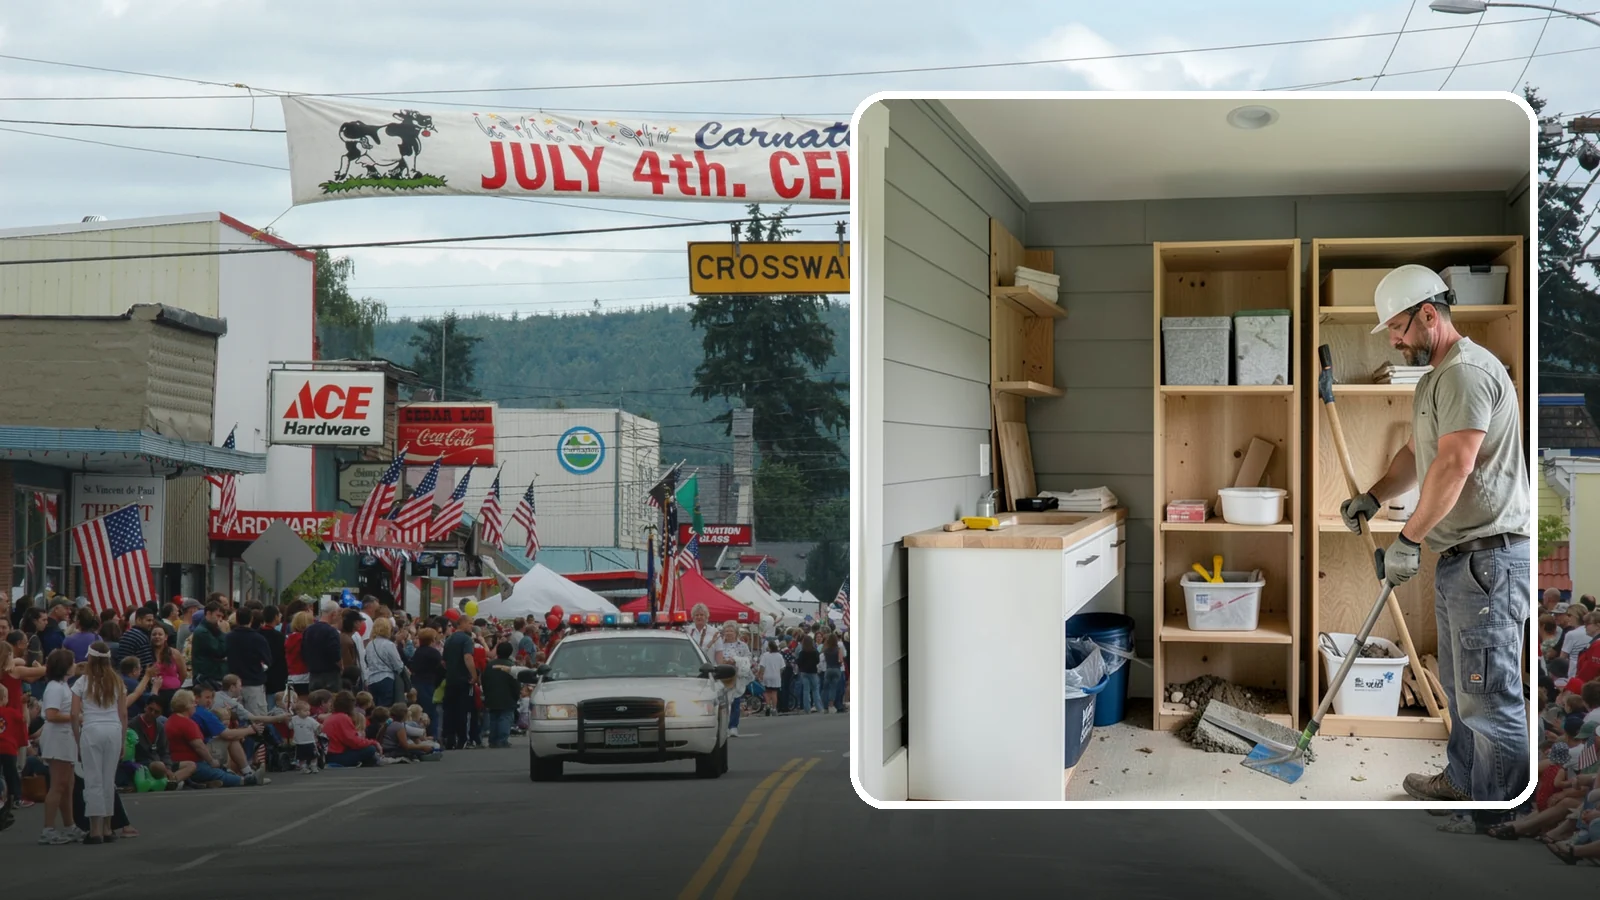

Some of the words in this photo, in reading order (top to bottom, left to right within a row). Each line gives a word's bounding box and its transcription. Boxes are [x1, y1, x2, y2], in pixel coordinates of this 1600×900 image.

[481, 141, 605, 192] JULY
[632, 150, 746, 197] 4th.
[697, 254, 850, 280] CROSSWA
[283, 380, 373, 420] ACE
[406, 409, 452, 422] CEDAR
[284, 421, 371, 436] Hardware
[416, 428, 477, 447] Coca-Cola
[354, 467, 384, 480] Simpl
[96, 485, 124, 494] Vincent
[126, 486, 136, 494] de
[138, 486, 155, 495] Paul
[212, 516, 331, 536] HARDARE
[688, 526, 742, 535] CRNATION
[699, 535, 731, 543] GLASS
